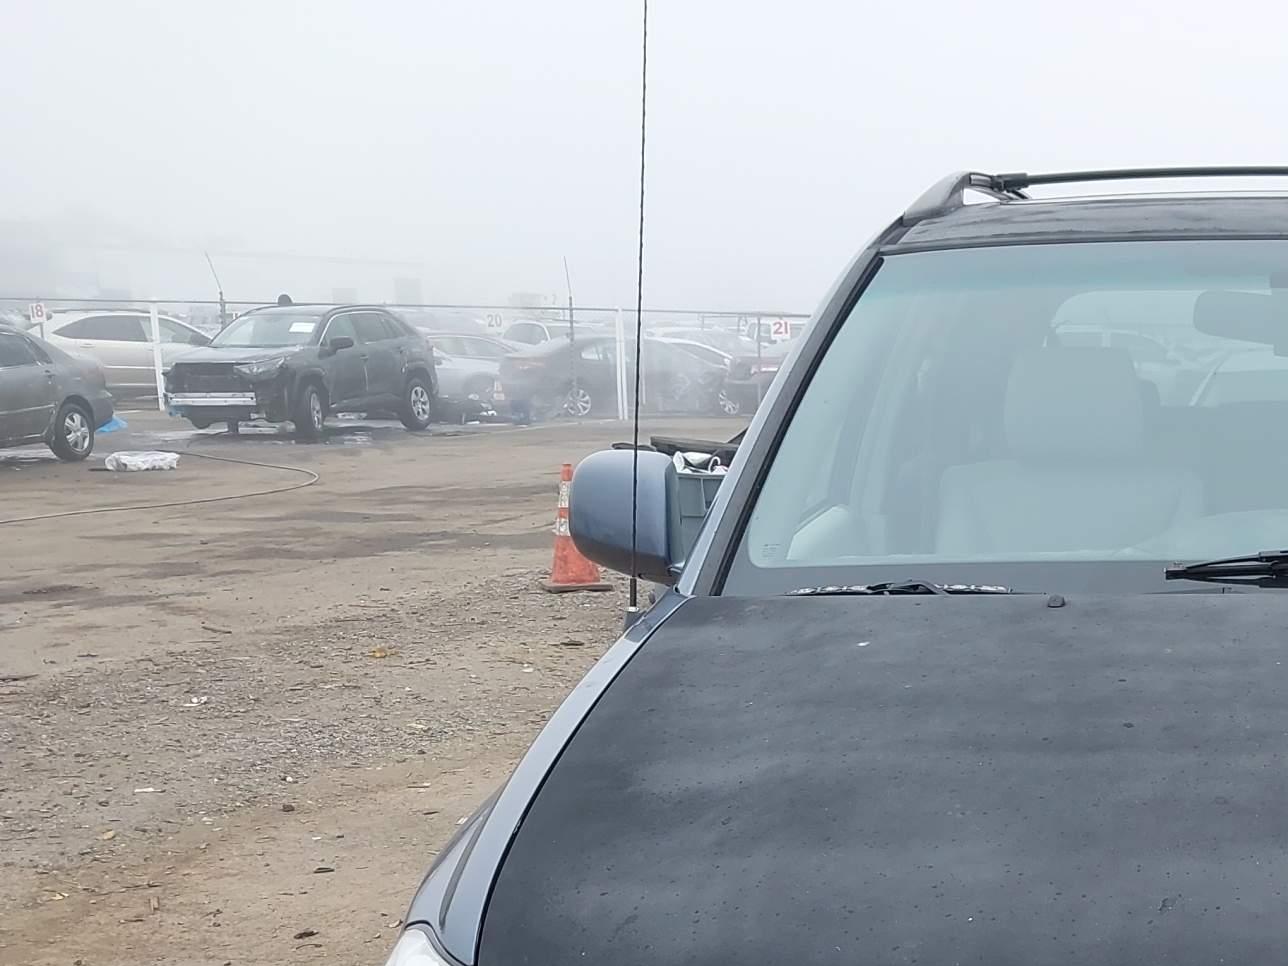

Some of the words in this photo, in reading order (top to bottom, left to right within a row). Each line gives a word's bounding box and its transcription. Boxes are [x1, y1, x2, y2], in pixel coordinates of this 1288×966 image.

[31, 304, 45, 319] 18
[487, 313, 502, 328] 20
[773, 321, 789, 335] 21
